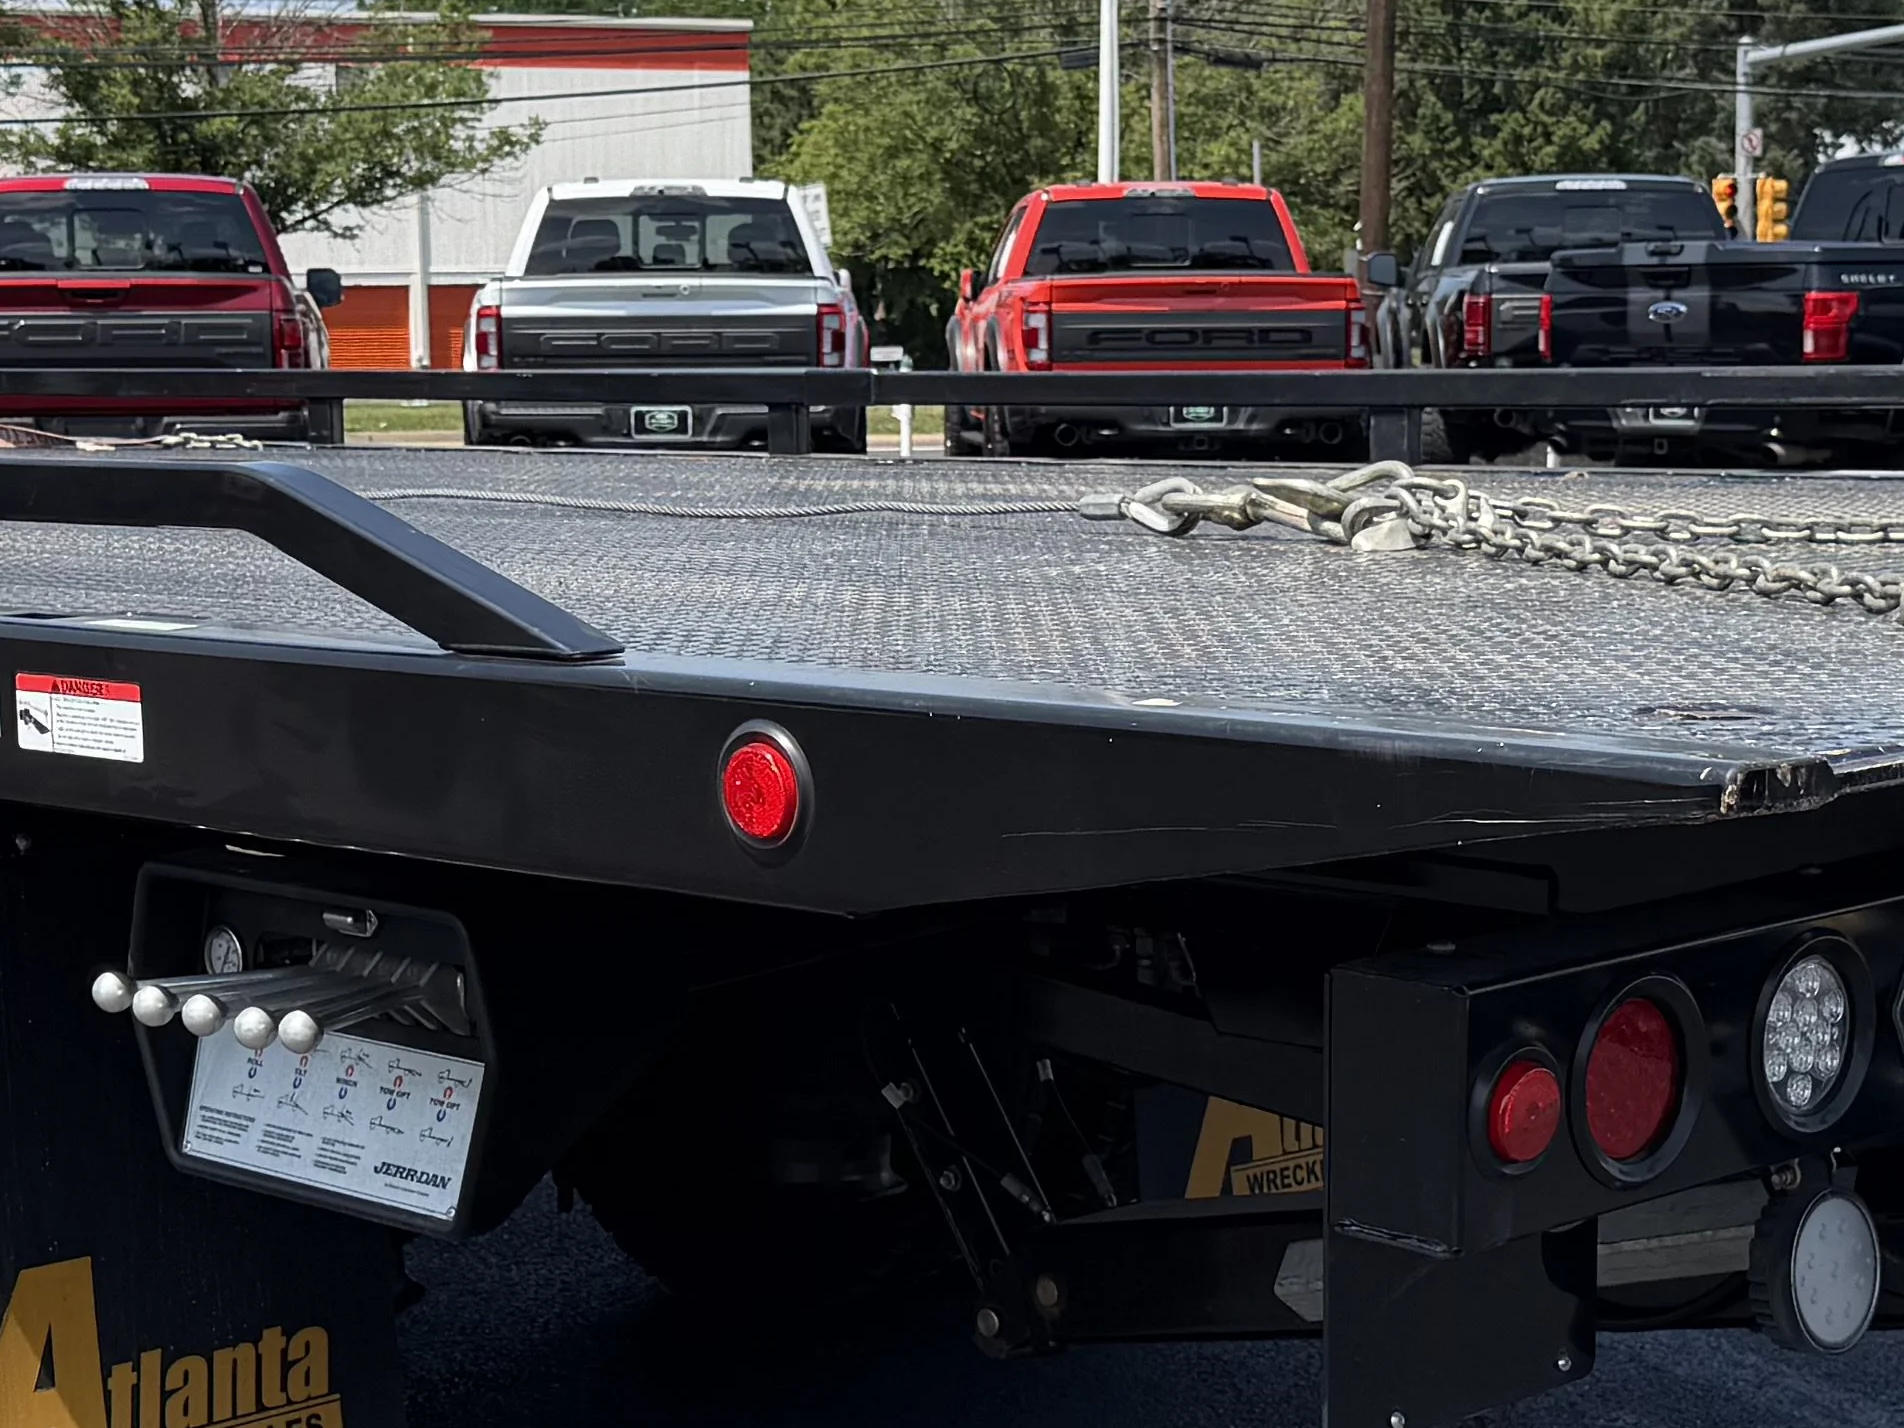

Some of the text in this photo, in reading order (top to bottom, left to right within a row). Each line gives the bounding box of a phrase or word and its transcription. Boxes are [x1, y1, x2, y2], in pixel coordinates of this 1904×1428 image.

[1087, 328, 1313, 346] FORD
[373, 1161, 452, 1190] JERR-DAN
[1246, 1161, 1324, 1194] WRECK
